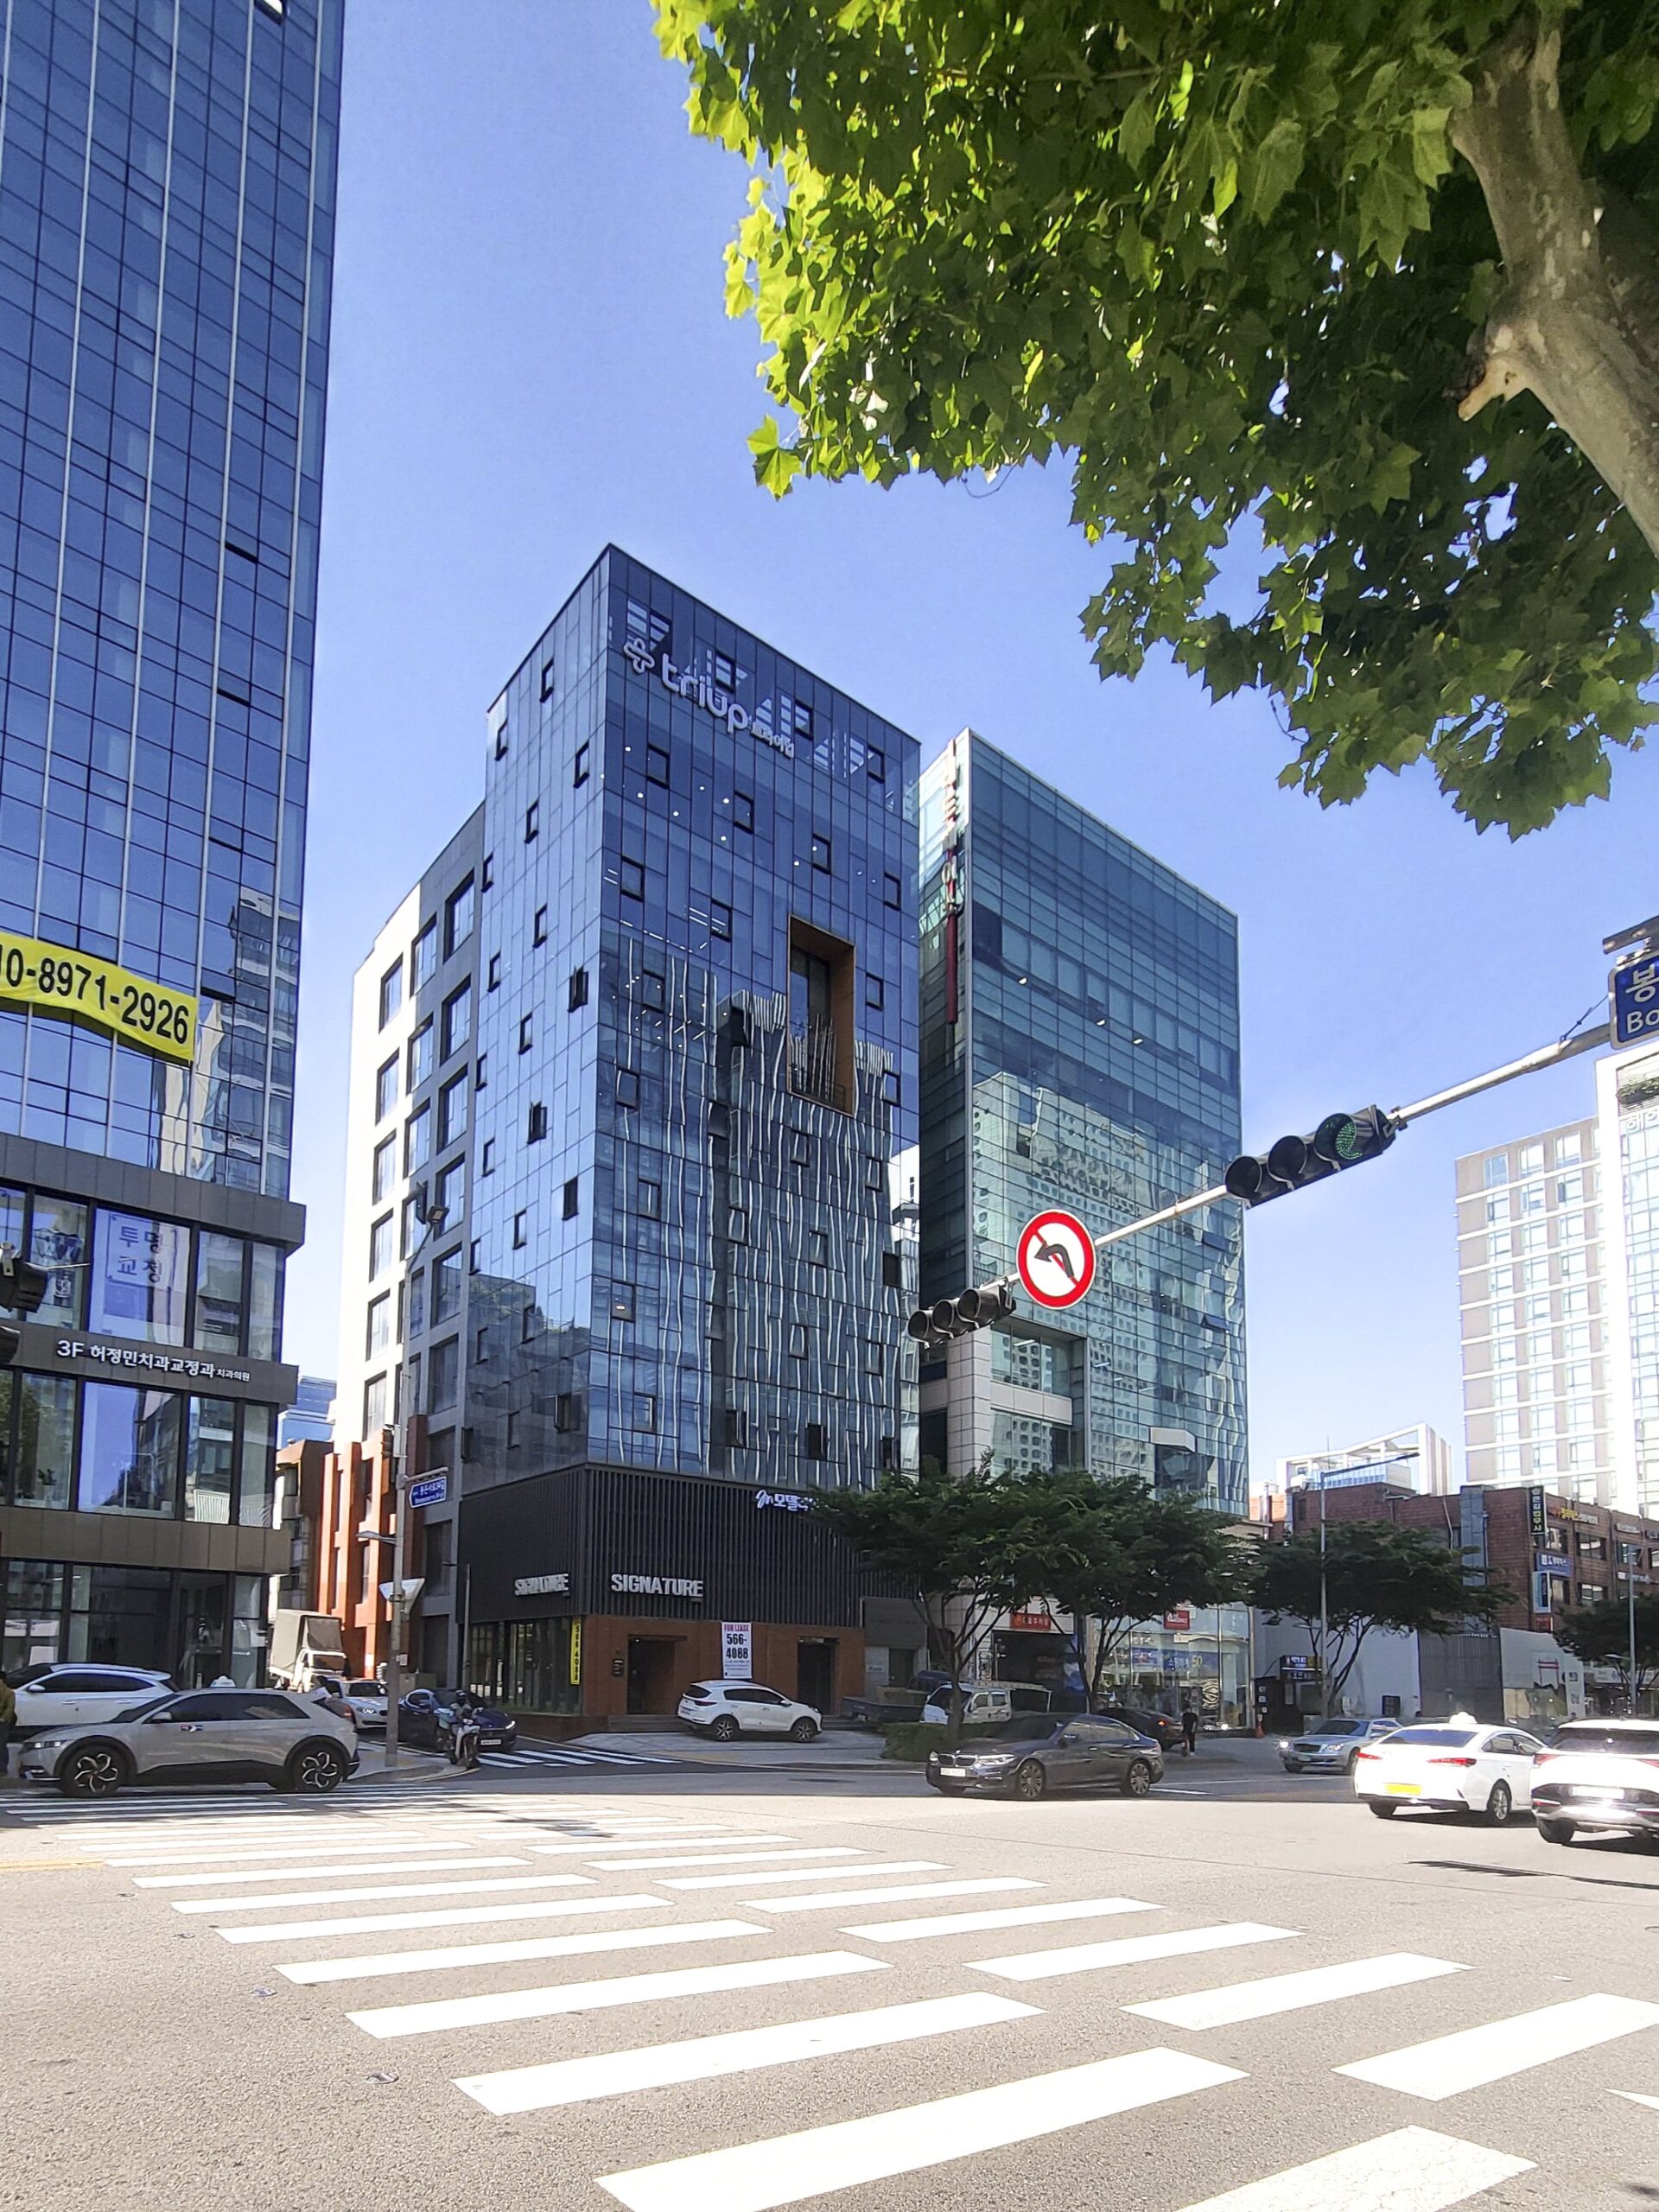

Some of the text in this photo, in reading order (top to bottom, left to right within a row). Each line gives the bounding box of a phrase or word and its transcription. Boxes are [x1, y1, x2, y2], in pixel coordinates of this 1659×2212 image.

[118, 1225, 163, 1254] 투명
[118, 1255, 162, 1283] 교정
[56, 1339, 251, 1382] 3F 허정민치과교정과 치과의원
[611, 1573, 703, 1598] SIGNATURE
[724, 1624, 734, 1632] FOR
